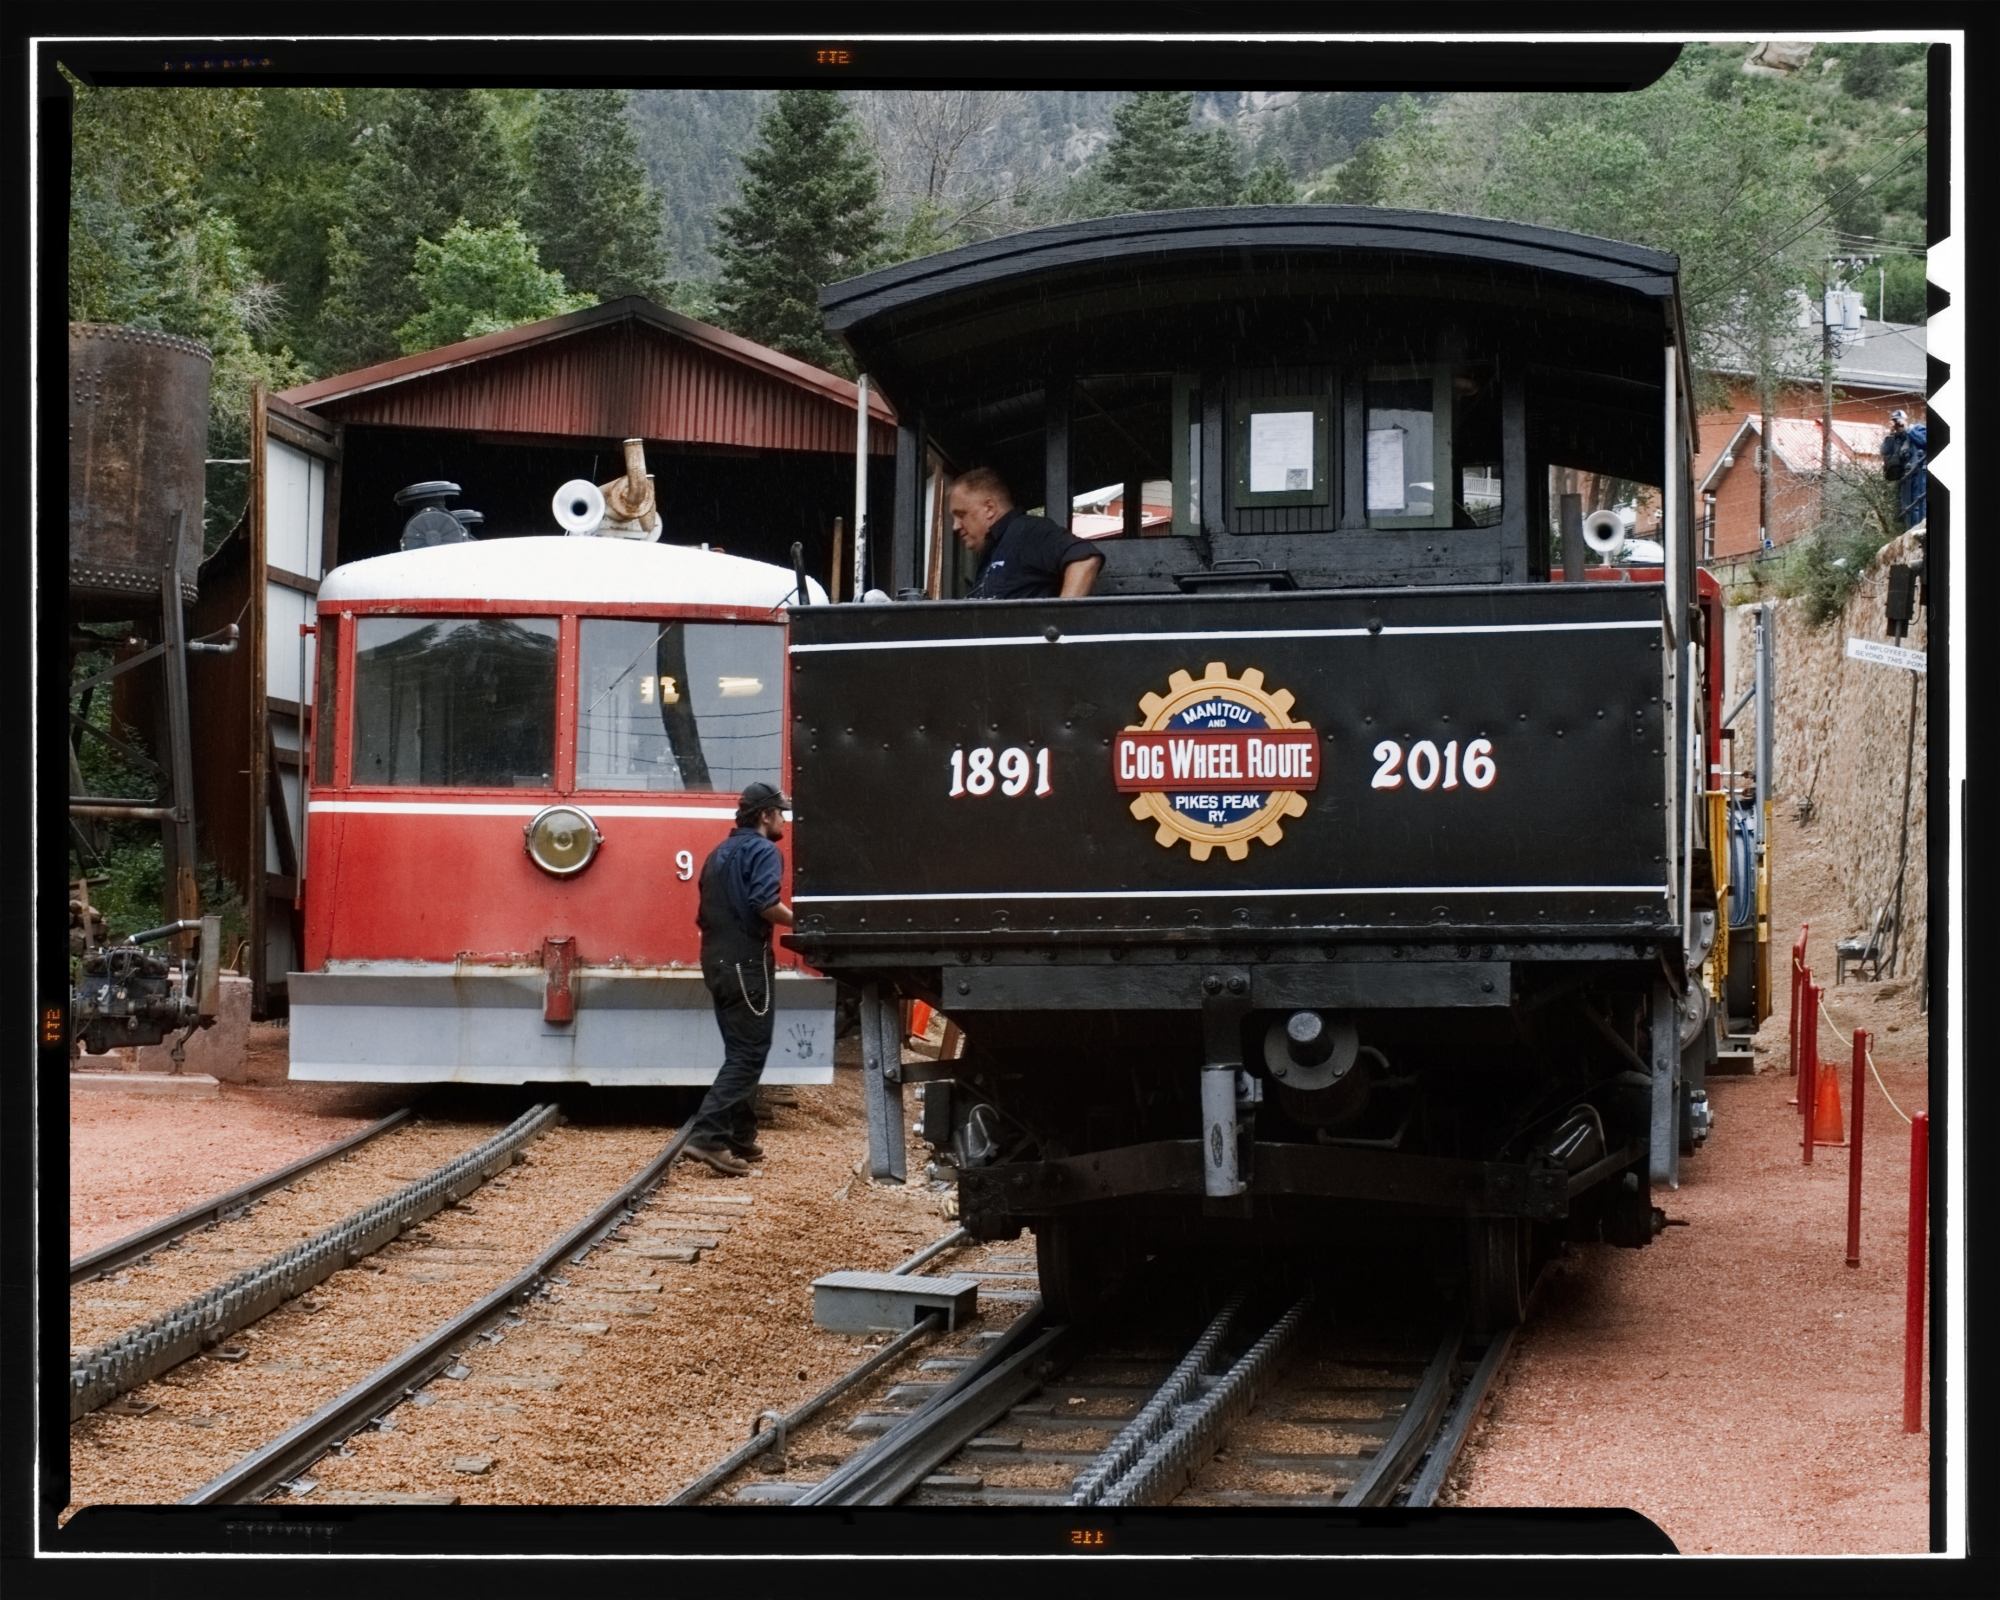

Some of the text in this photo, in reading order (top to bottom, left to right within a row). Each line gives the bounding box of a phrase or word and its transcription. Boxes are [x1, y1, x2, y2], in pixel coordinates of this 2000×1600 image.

[1855, 649, 1884, 661] BEYOND
[1887, 656, 1903, 665] THIS
[1864, 643, 1926, 662] EMPLOYEES ONL
[1181, 702, 1252, 724] MANITOU
[1207, 719, 1227, 728] AND
[1120, 738, 1313, 780] COG WHEEL ROUTE
[1371, 738, 1497, 791] 2016
[949, 747, 1053, 798] 1891
[1175, 794, 1261, 809] PIKES PEAK
[1208, 810, 1228, 822] RY.
[675, 850, 694, 881] 9
